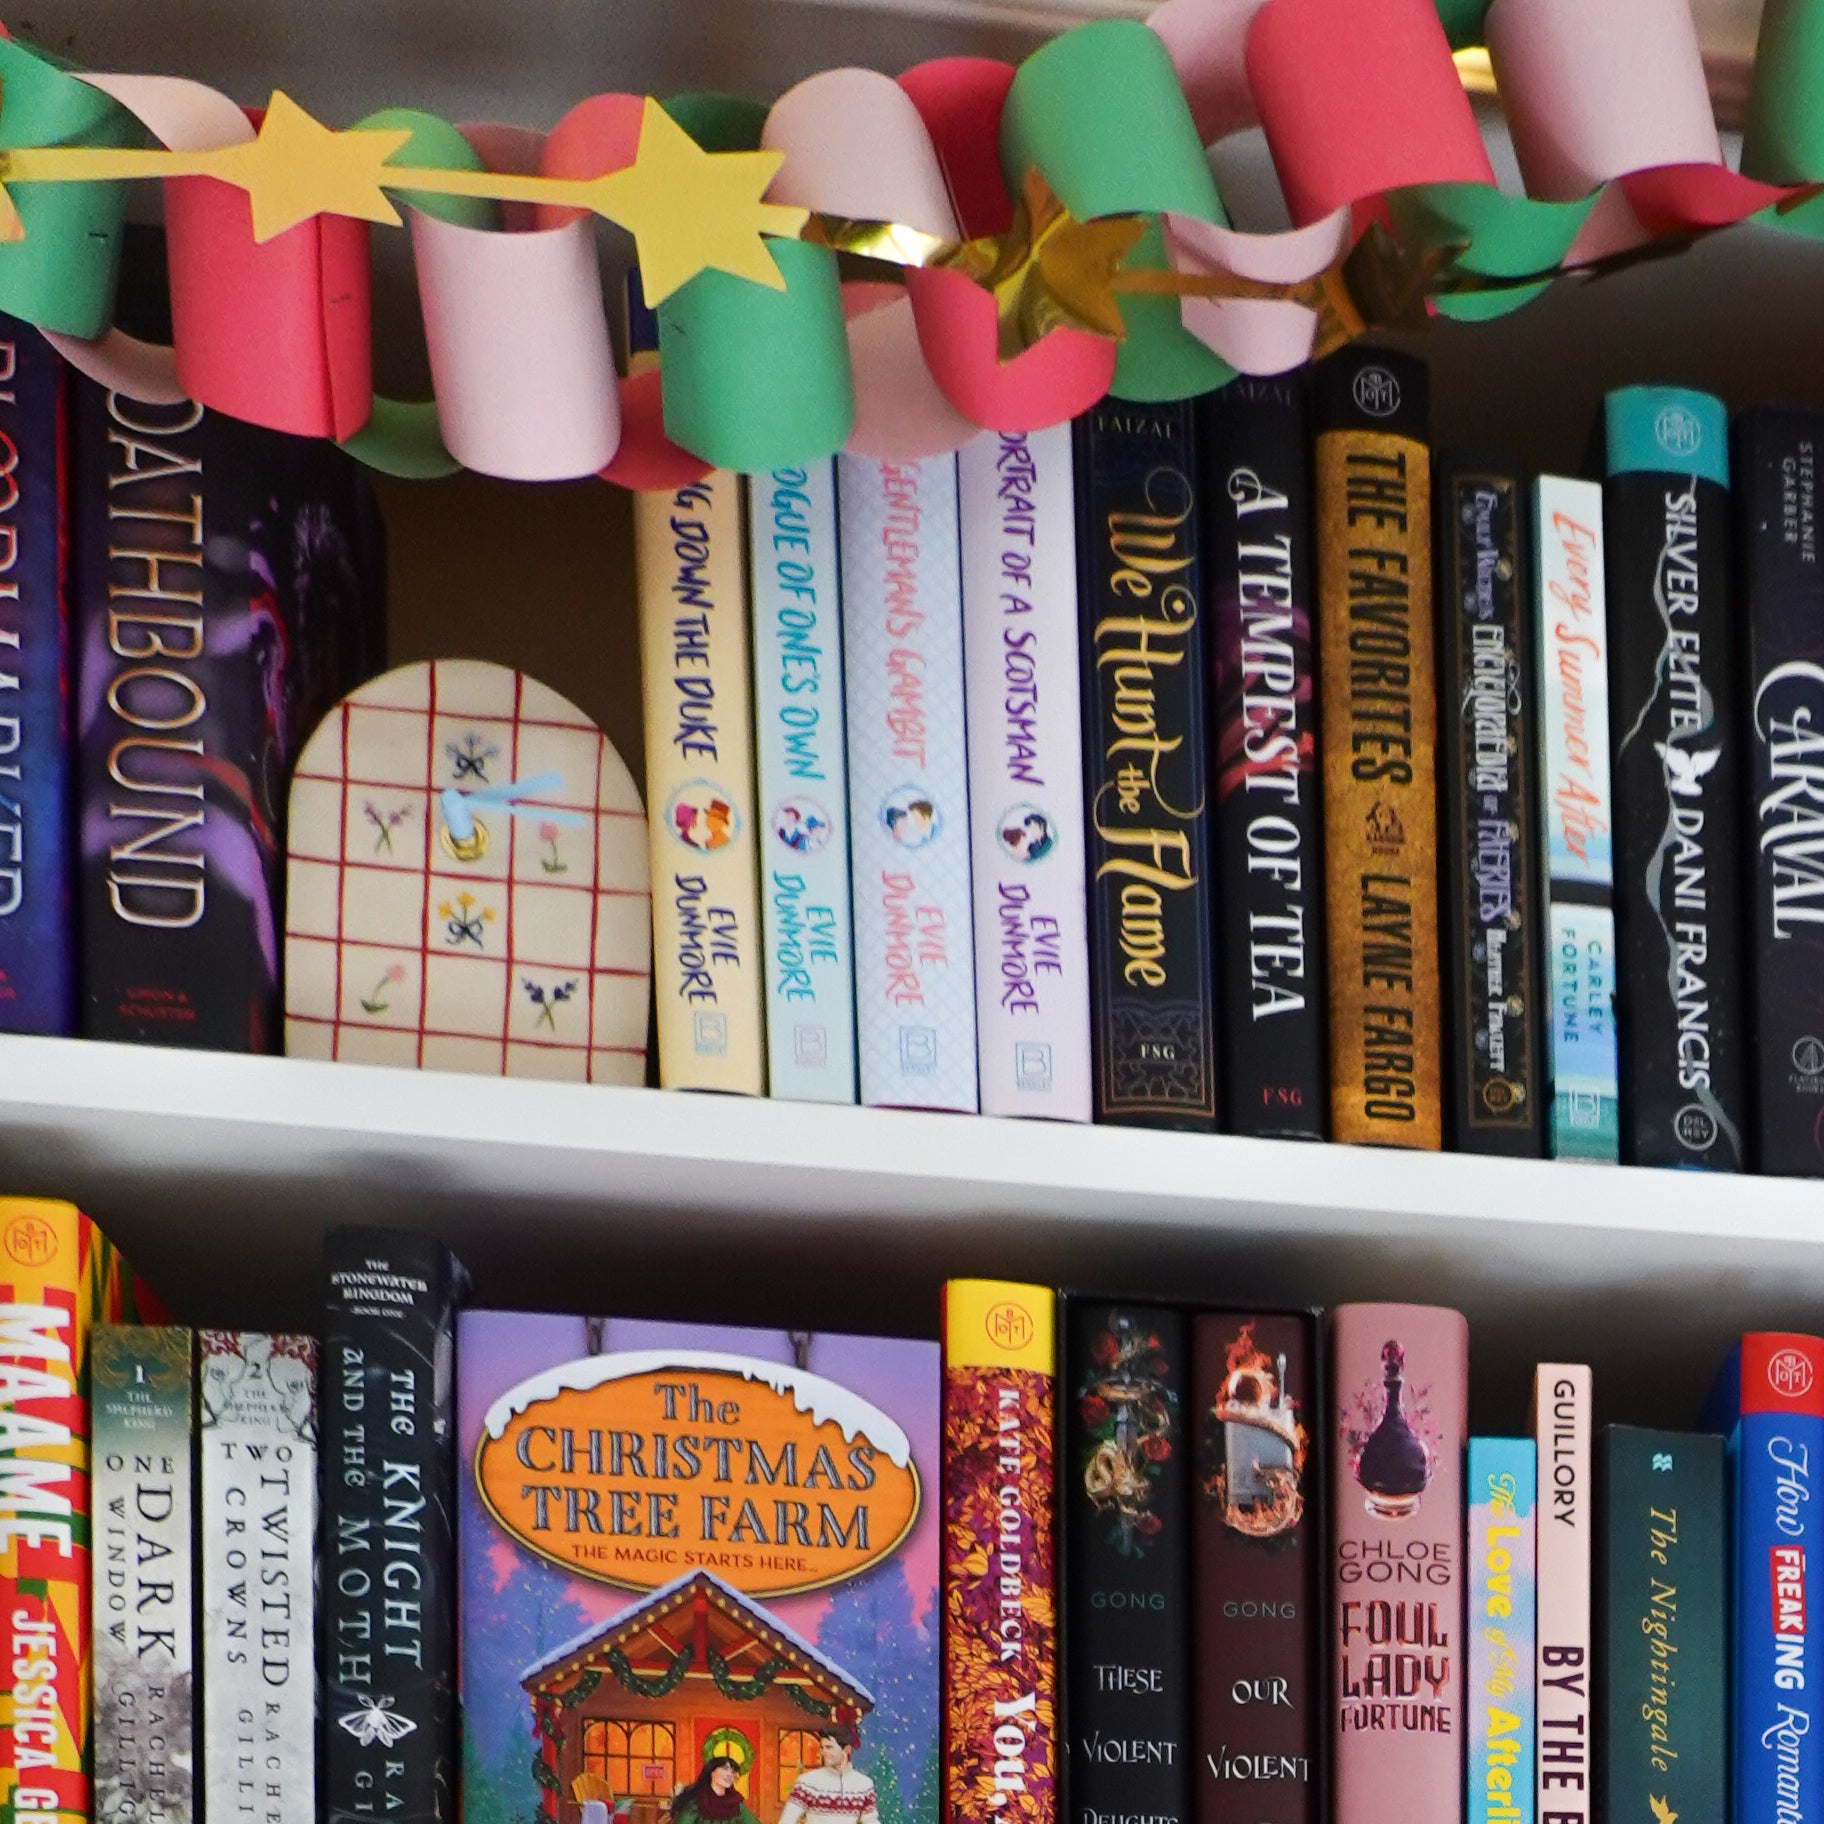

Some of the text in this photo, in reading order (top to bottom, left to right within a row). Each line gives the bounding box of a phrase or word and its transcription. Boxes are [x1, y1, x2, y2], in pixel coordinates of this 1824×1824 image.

[674, 519, 715, 605] DOWN
[1664, 490, 1704, 731] SILVER ELITE
[676, 606, 708, 668] THE
[1346, 451, 1411, 786] THE FAVORITES
[674, 667, 718, 763] DUKE
[1095, 467, 1198, 988] We Hunt the Flame
[1226, 467, 1305, 1022] A TEMPEST OF TEA
[677, 873, 717, 1004] DUNMORE
[708, 907, 740, 967] EVIE
[1560, 928, 1577, 1043] FORTUNE
[1672, 808, 1712, 1092] DANI FRANCIS
[1361, 873, 1415, 1125] LAYNE FARGO
[1587, 941, 1603, 1035] CARLEY
[221, 1443, 293, 1464] TWO
[655, 1382, 741, 1427] The
[106, 1455, 174, 1473] ONE
[515, 1426, 879, 1493] CHRISTMAS
[1552, 1380, 1574, 1529] GUILLORY
[1768, 1437, 1813, 1537] How
[520, 1483, 870, 1551] TREE FARM
[571, 1544, 608, 1560] THE
[614, 1547, 678, 1565] MAGIC
[683, 1552, 752, 1569] STARTS
[1338, 1539, 1450, 1562] CHLOE
[108, 1496, 127, 1644] WINDOW
[134, 1482, 175, 1660] DARK
[226, 1487, 247, 1667] CROWNS
[261, 1466, 291, 1688] TWISTED
[1338, 1560, 1450, 1586] GONG
[1771, 1548, 1804, 1690] FREAKING
[1340, 1600, 1449, 1653] FOUL
[1542, 1646, 1585, 1698] BY
[1648, 1574, 1679, 1772] Nightingale
[10, 1610, 57, 1778] JESSICA
[1340, 1703, 1450, 1734] FORTUNE
[1342, 1654, 1450, 1701] LADY
[991, 1692, 1036, 1808] You,
[1542, 1708, 1584, 1791] THE
